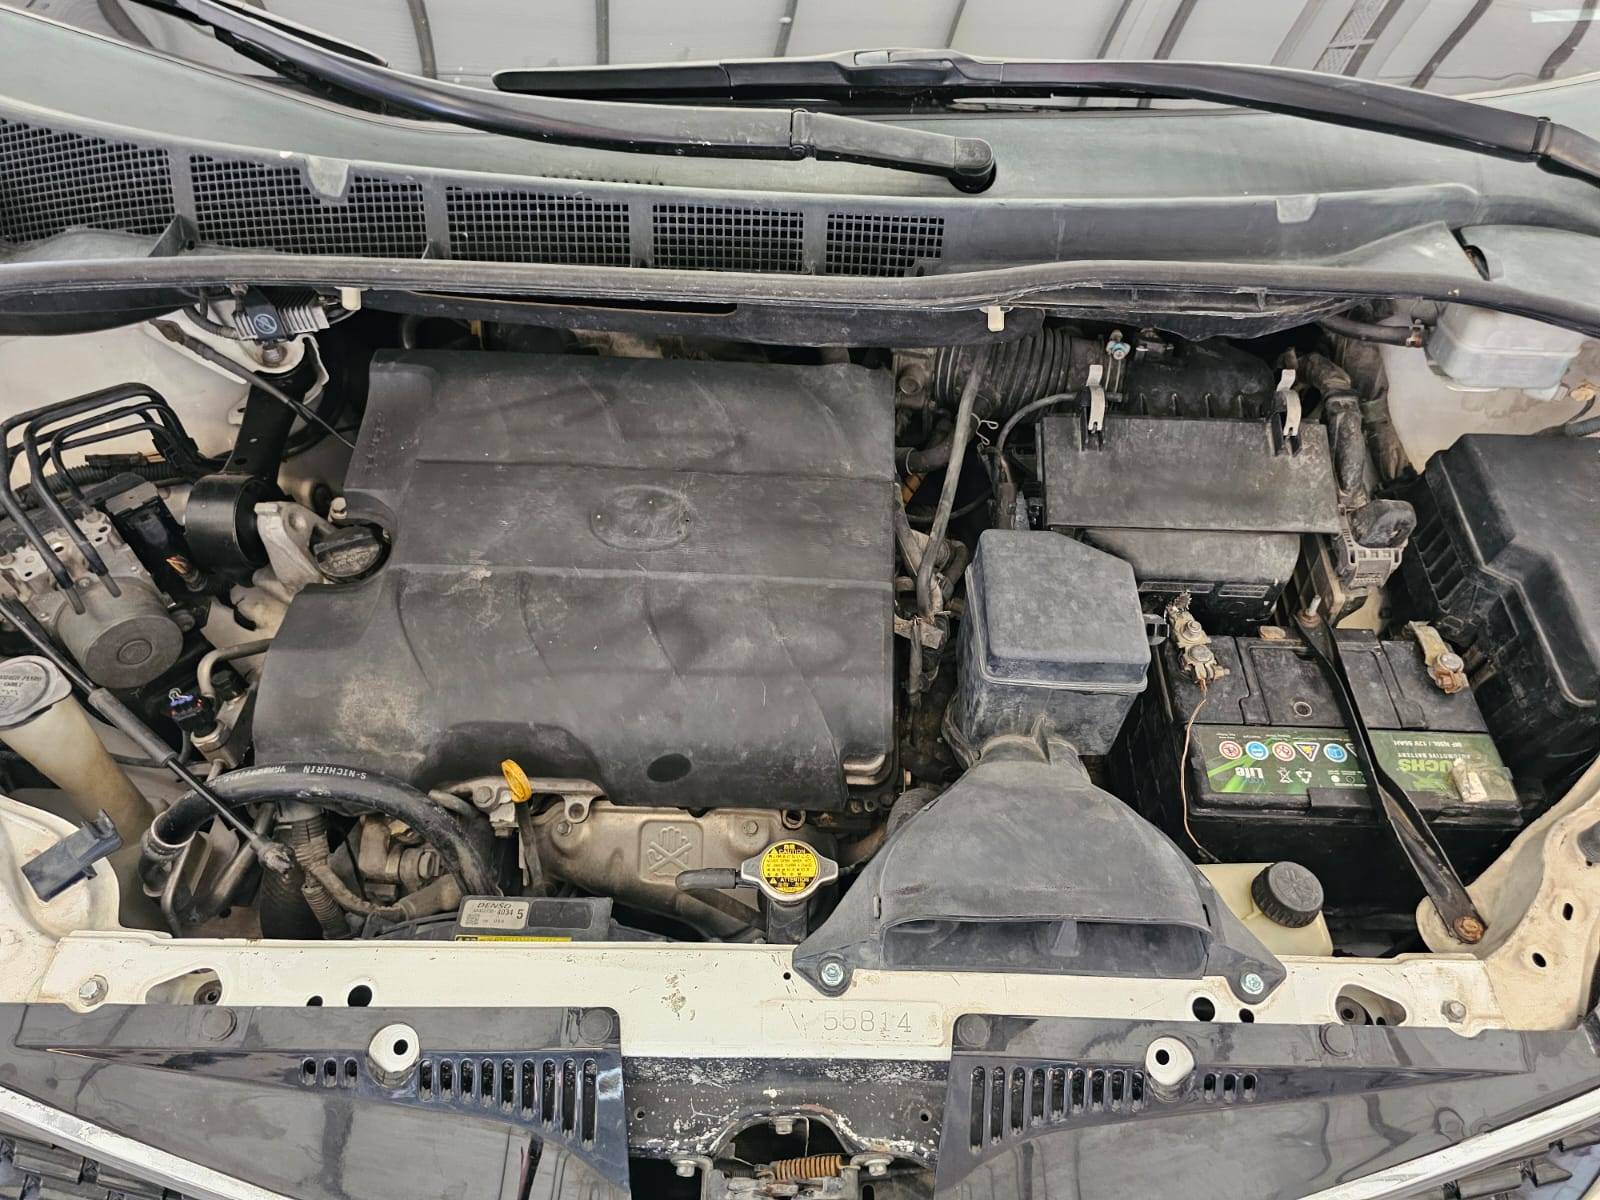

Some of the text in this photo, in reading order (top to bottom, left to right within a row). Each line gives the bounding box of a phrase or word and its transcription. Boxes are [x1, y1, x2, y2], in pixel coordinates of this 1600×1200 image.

[302, 764, 367, 780] S-NICHIRIN
[1234, 766, 1264, 779] Life
[515, 908, 525, 920] 5
[823, 1009, 912, 1033] 55814
